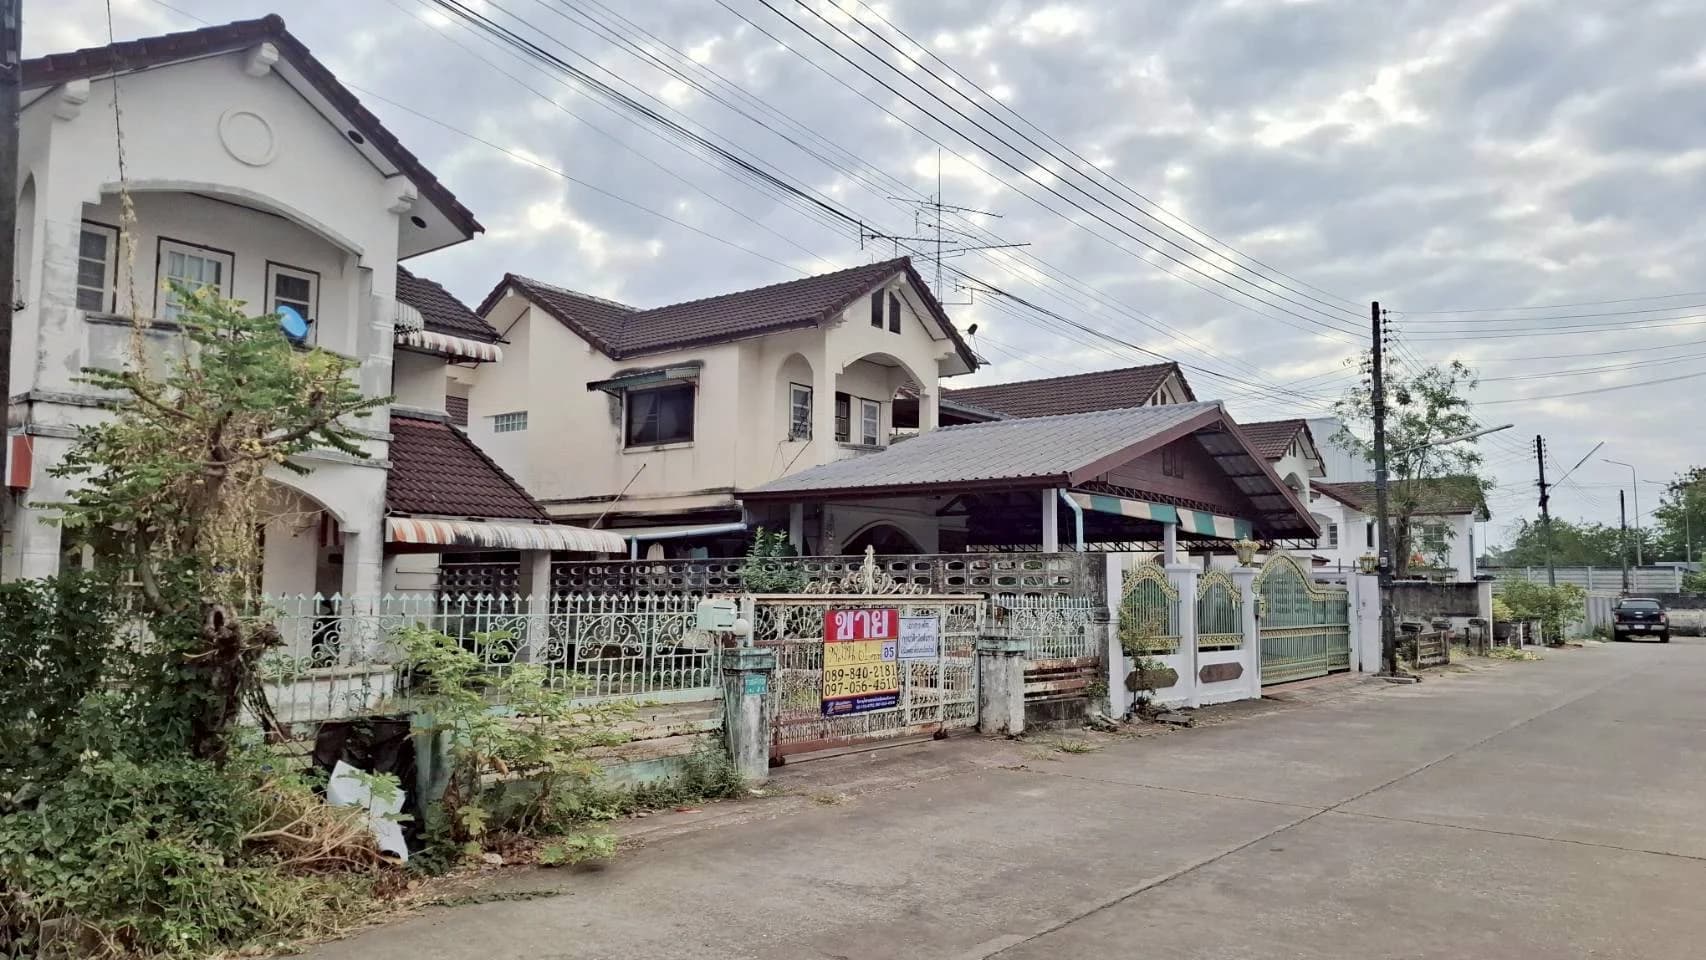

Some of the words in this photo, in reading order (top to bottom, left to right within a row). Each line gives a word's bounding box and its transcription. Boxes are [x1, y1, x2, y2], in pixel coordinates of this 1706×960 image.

[835, 610, 889, 640] ขาย
[825, 665, 896, 683] 089-840-2181
[825, 677, 897, 696] 097-056-4510
